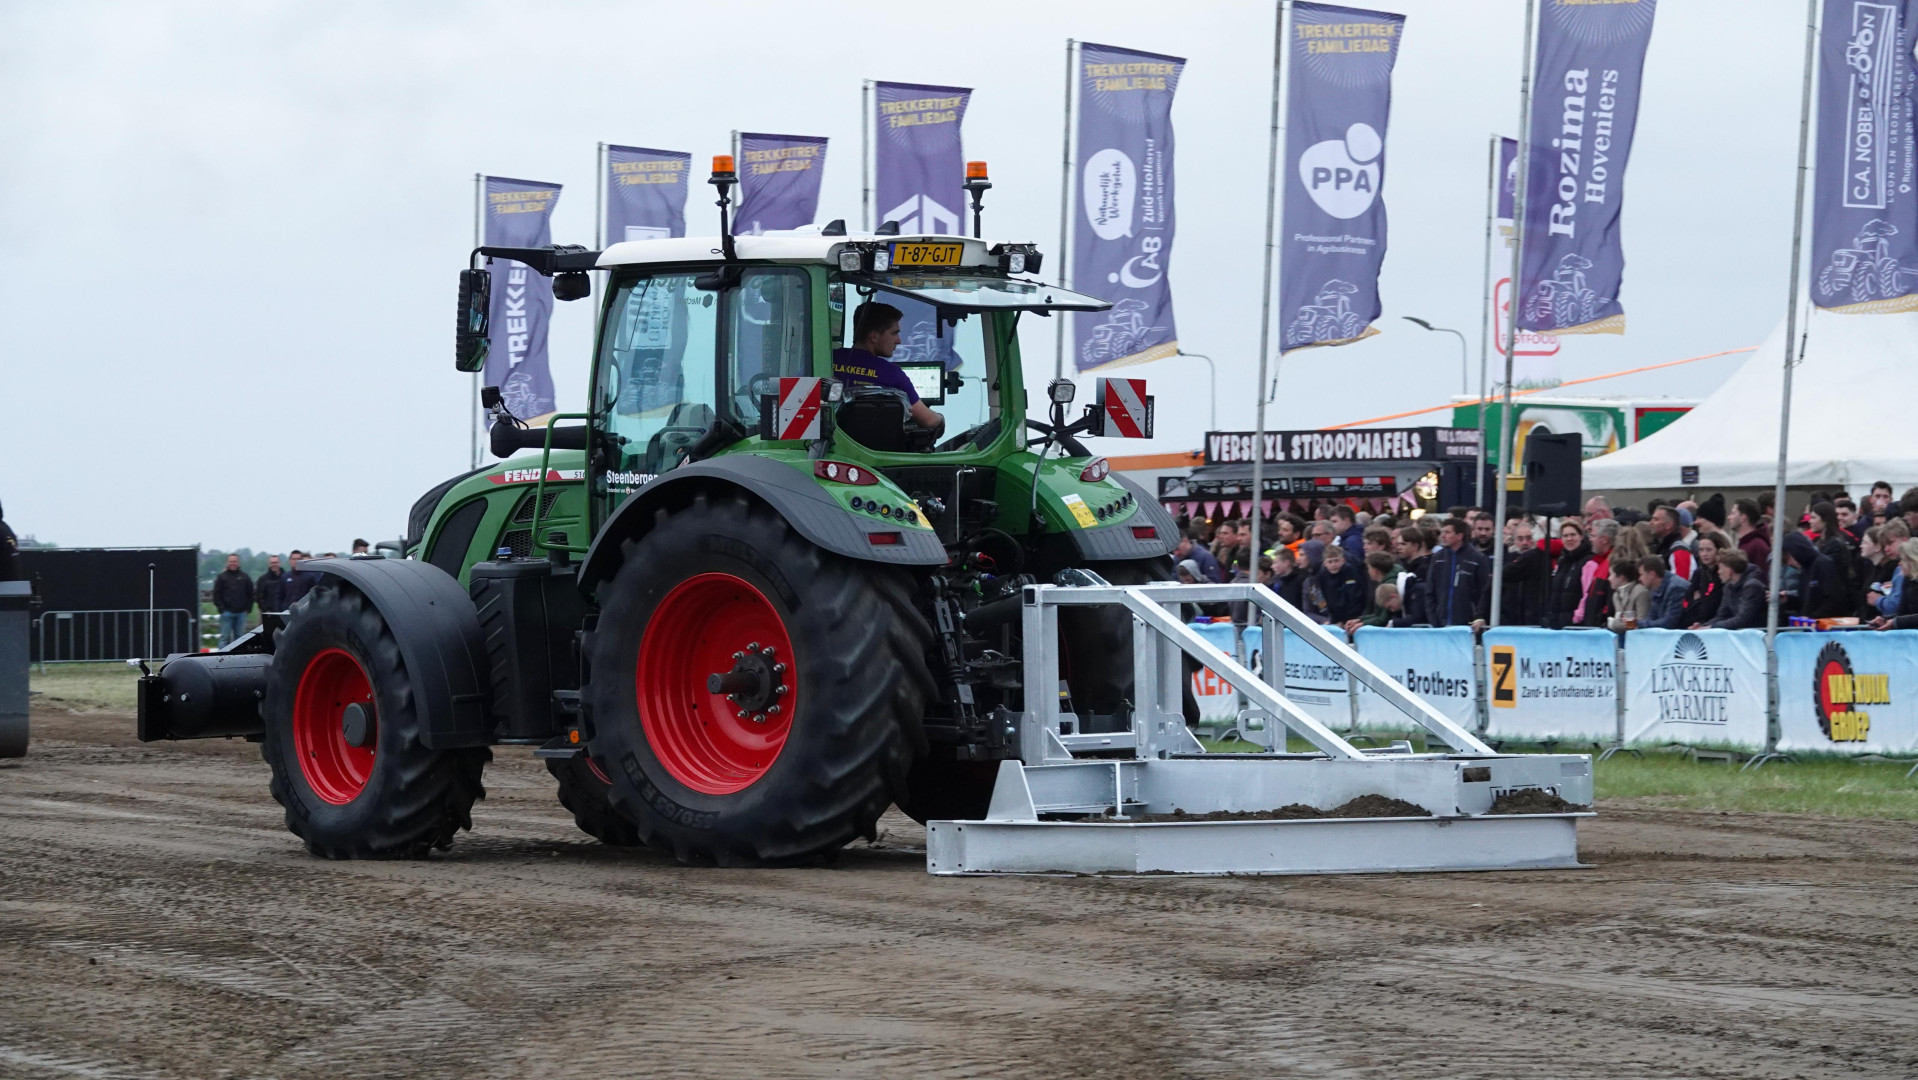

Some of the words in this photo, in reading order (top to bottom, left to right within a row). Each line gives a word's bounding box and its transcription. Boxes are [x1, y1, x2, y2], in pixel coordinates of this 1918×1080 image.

[1296, 23, 1397, 39] TREKKERTREK
[1308, 39, 1390, 54] FAMILIEDAG
[1085, 62, 1176, 77] TREKKERTREK
[1096, 77, 1166, 91] FAMILIEDAG
[880, 96, 962, 114] TREKKERTREK
[890, 111, 957, 128] FAMILIEDAG
[1584, 69, 1619, 204] Hoveniers
[1855, 102, 1874, 162] NOBEL
[744, 145, 820, 162] TREKKERTREK
[1548, 68, 1589, 239] Rozima
[611, 161, 684, 174] TREKKERTREK
[1140, 138, 1156, 223] Zuid-Holland
[1312, 167, 1371, 193] PPA
[1094, 172, 1112, 226] Natuurlijk
[901, 246, 956, 263] T-87-GJT
[1501, 333, 1558, 345] FSTFOOD
[1263, 434, 1285, 461] XL
[1291, 431, 1422, 460] STROOPWAFELS
[1494, 652, 1513, 701] Z
[1520, 657, 1535, 678] M.
[1538, 661, 1562, 678] van
[1566, 656, 1613, 678] Zanten
[1407, 668, 1469, 698] Brothers
[1552, 685, 1596, 698] Grindhandel
[1651, 665, 1734, 694] LENGKEEK
[1658, 695, 1729, 723] WARMTE
[1829, 711, 1870, 743] GROEP
